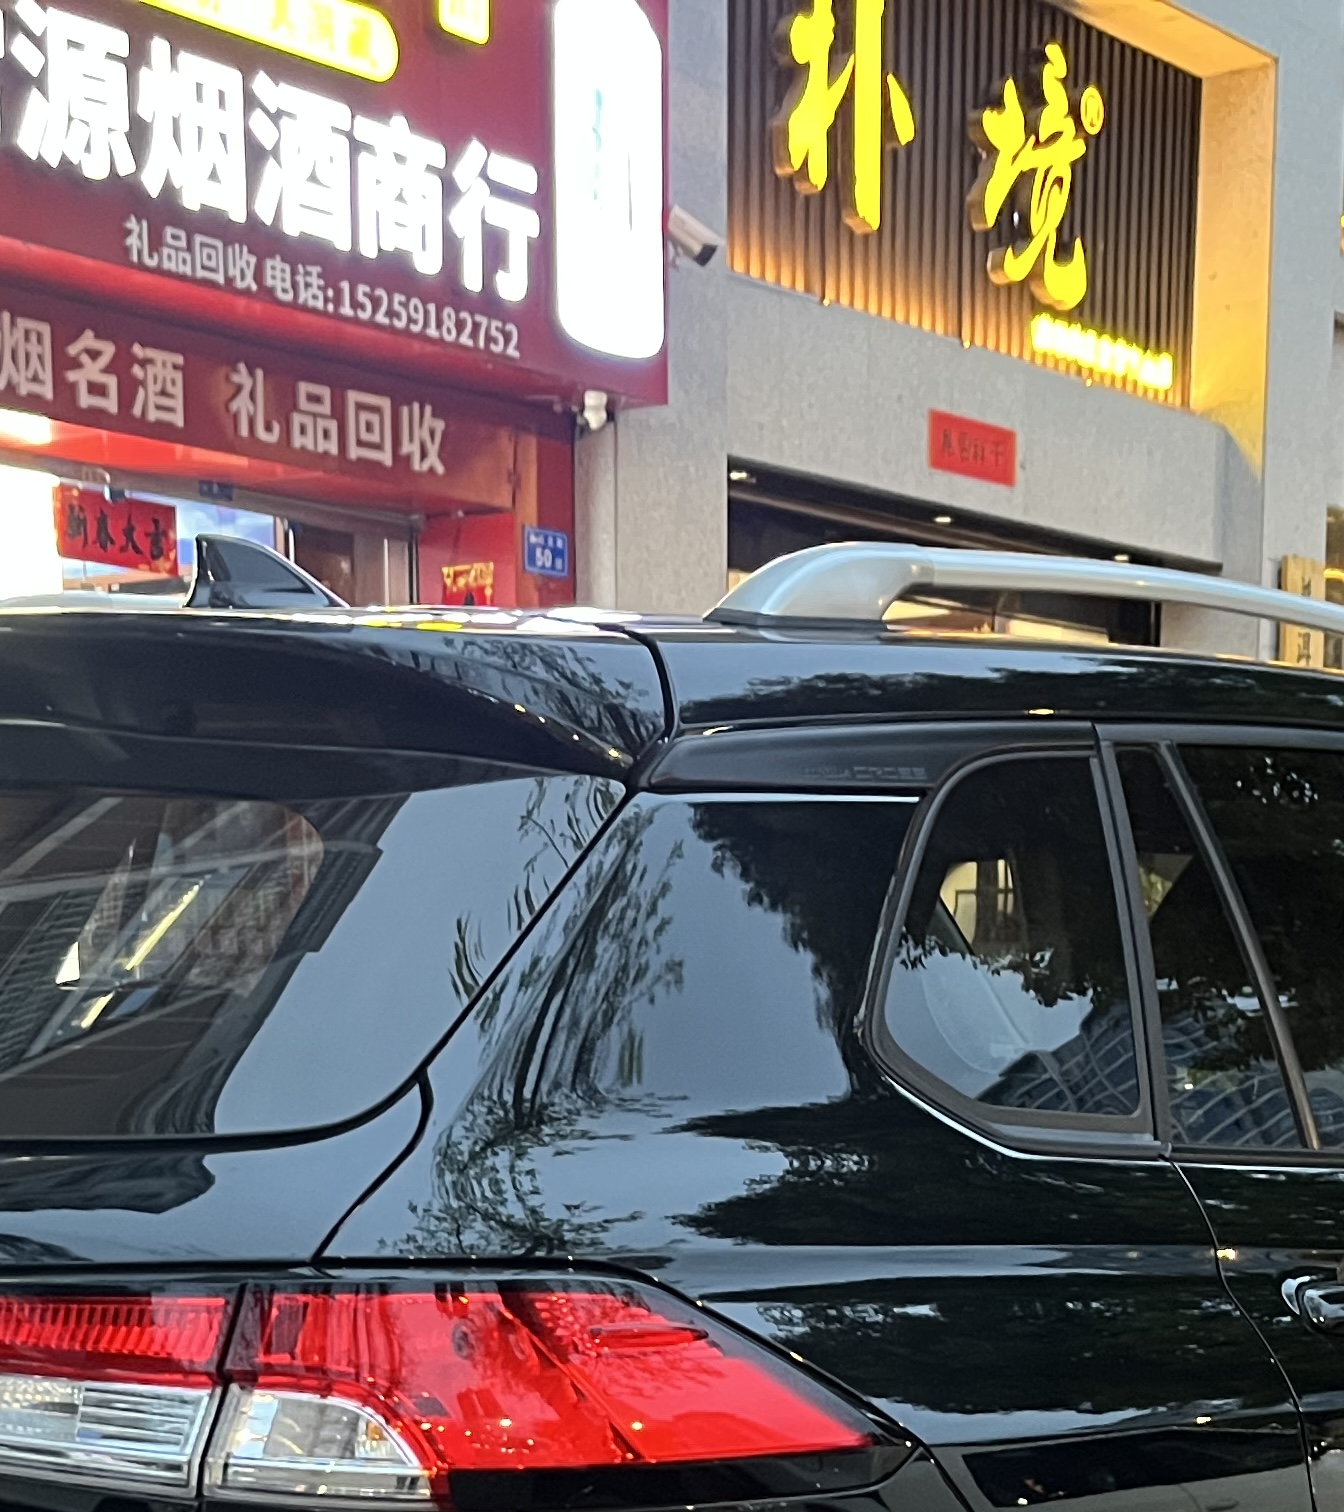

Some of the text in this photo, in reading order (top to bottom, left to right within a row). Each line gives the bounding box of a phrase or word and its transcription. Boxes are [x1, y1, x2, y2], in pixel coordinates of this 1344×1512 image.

[123, 213, 258, 292] 礼品回收
[230, 361, 447, 476] 礼品回收
